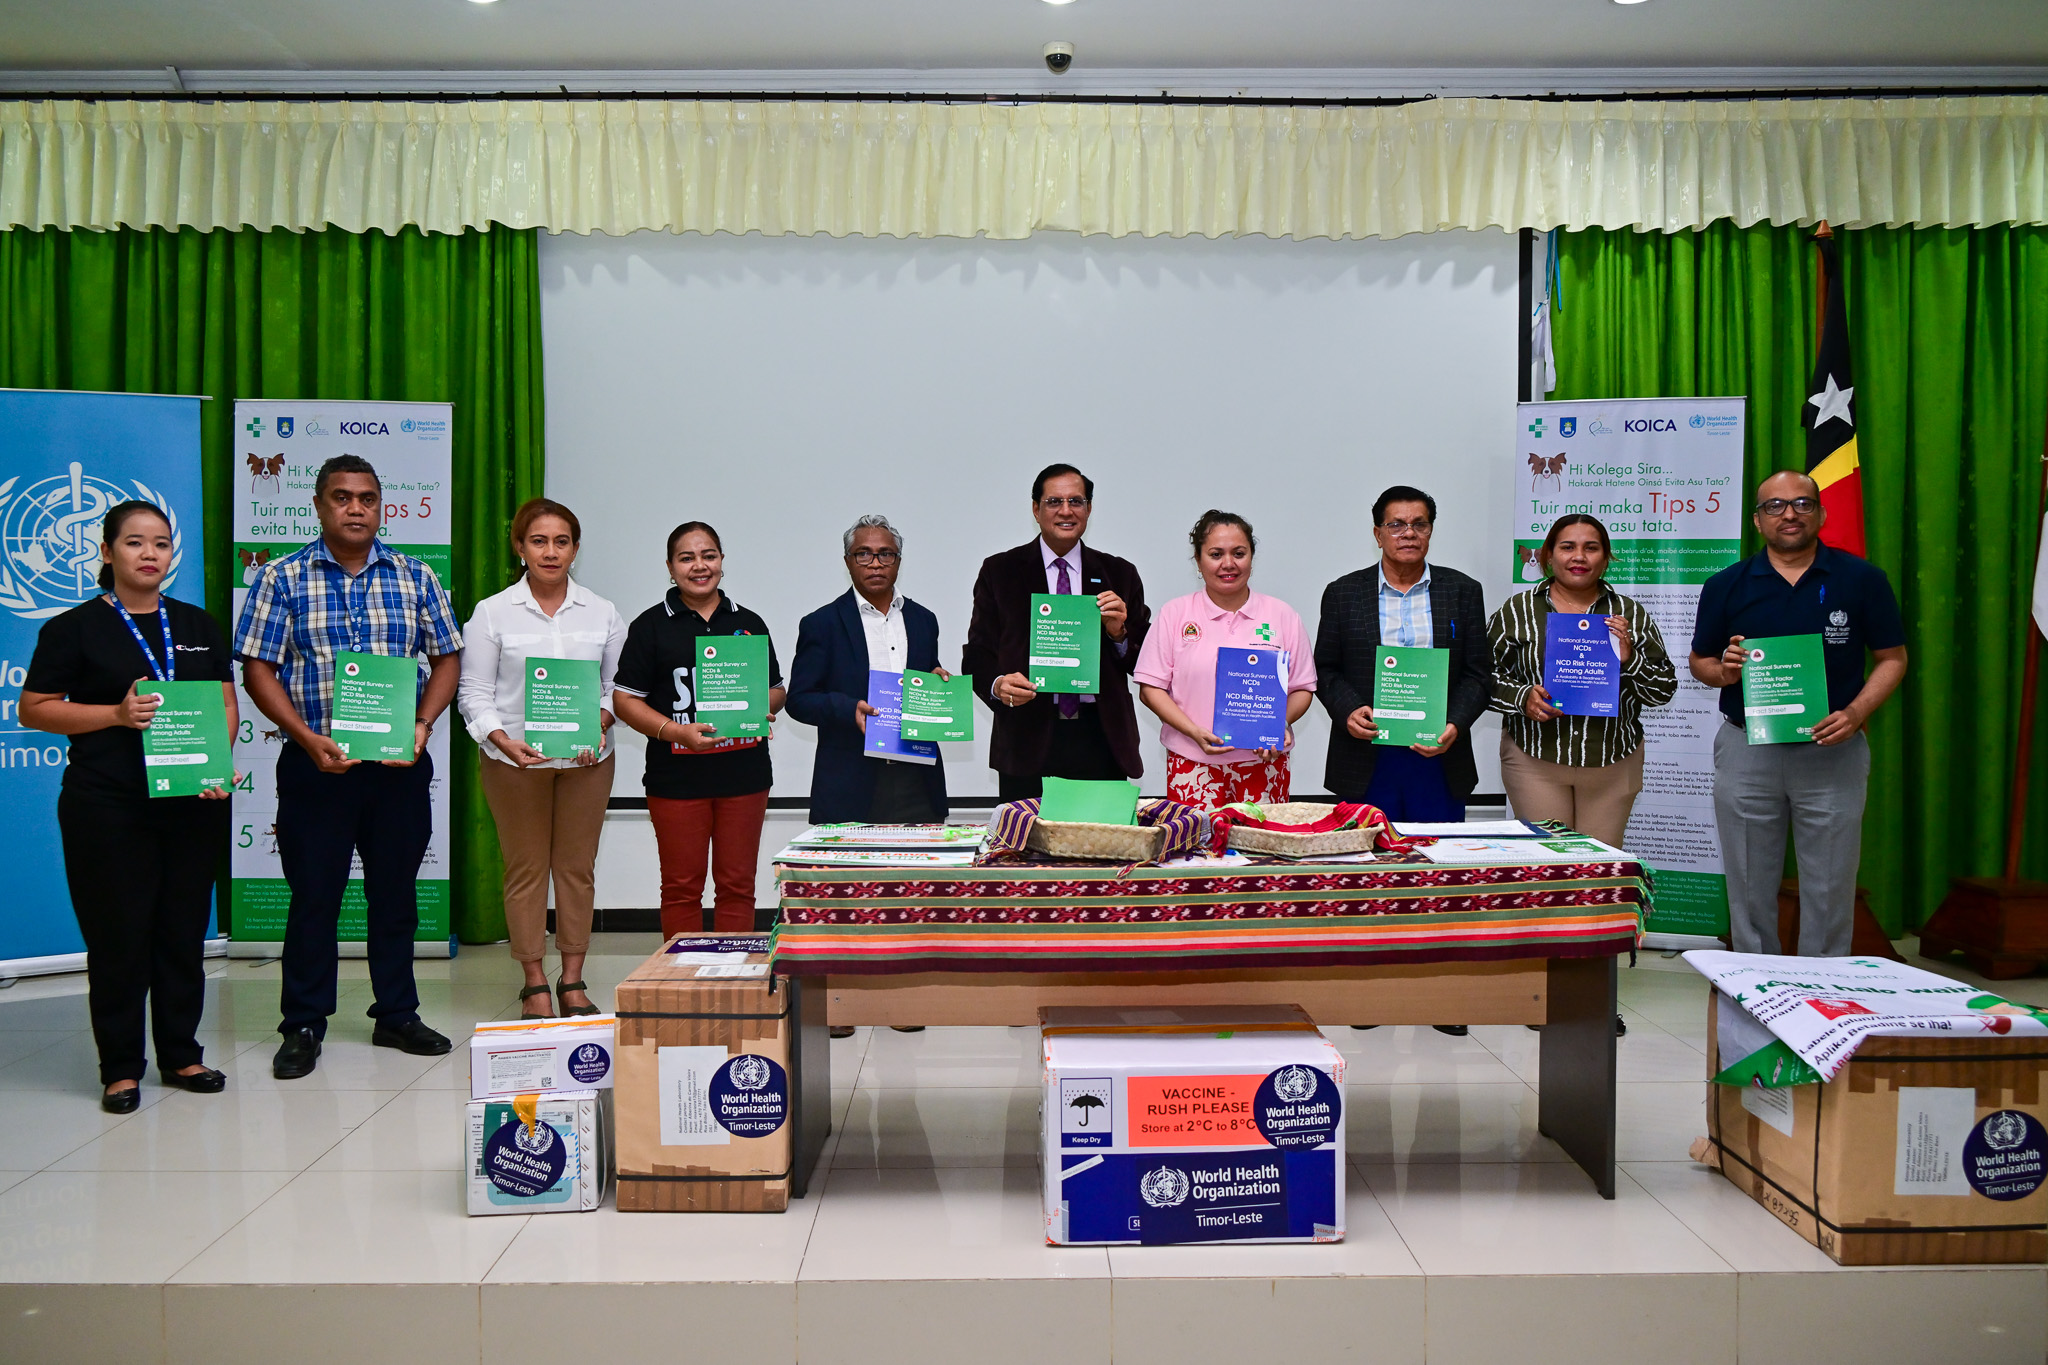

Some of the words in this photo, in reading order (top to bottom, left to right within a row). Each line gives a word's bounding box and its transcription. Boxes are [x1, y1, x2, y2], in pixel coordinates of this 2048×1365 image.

[340, 422, 389, 435] KOICA
[1625, 419, 1677, 432] KOICA
[288, 465, 301, 476] Hi
[1570, 464, 1582, 475] Hi
[1588, 462, 1632, 478] Kolega
[1637, 463, 1673, 474] Sira...
[1568, 479, 1603, 487] Hakarak
[1638, 478, 1662, 486] Oinsá
[1705, 477, 1730, 486] Tata?
[251, 502, 279, 517] Tuir
[284, 502, 312, 517] mai
[418, 497, 431, 518] 5
[1531, 500, 1559, 514] Tuir
[1565, 499, 1593, 514] mai
[1599, 499, 1643, 514] maka
[1649, 492, 1696, 520] Tips
[1705, 492, 1720, 513] 5
[251, 520, 287, 535] evita
[1610, 522, 1636, 532] asu
[1643, 520, 1677, 532] tata.
[1559, 667, 1582, 675] Among
[1228, 701, 1251, 709] Among
[240, 720, 253, 743] 3
[238, 771, 254, 793] 4
[238, 825, 253, 848] 5
[1832, 984, 1897, 994] halo
[1770, 997, 1790, 1010] bee
[1799, 1029, 1836, 1054] Labele
[1814, 1037, 1848, 1065] Aplika
[1848, 1021, 1906, 1036] Betadine
[1928, 1020, 1952, 1030] iha!
[721, 1094, 748, 1104] World
[751, 1092, 781, 1103] Health
[1162, 1088, 1226, 1099] VACCINE
[721, 1104, 781, 1116] Organization
[1147, 1103, 1188, 1115] RUSH
[1193, 1102, 1250, 1114] PLEASE
[1266, 1105, 1294, 1118] World
[1298, 1102, 1329, 1115] Health
[729, 1122, 776, 1131] Timor-Leste
[1141, 1124, 1170, 1133] Store
[1174, 1124, 1183, 1132] at
[1187, 1120, 1213, 1132] 2°C
[1216, 1122, 1227, 1131] to
[1230, 1118, 1256, 1130] 8°C
[1266, 1115, 1330, 1130] Organization
[1275, 1134, 1325, 1145] Timor-Leste
[498, 1146, 523, 1162] World
[524, 1155, 552, 1173] Health
[1976, 1154, 2004, 1167] World
[2007, 1149, 2040, 1162] Health
[494, 1155, 548, 1182] Organization
[1192, 1167, 1231, 1184] World
[1236, 1164, 1279, 1180] Health
[1976, 1161, 2040, 1179] Organization
[493, 1174, 535, 1196] Timor-Leste
[1193, 1181, 1280, 1201] Organization
[1985, 1181, 2035, 1195] Timor-Leste
[1196, 1212, 1263, 1227] Timor-Leste
